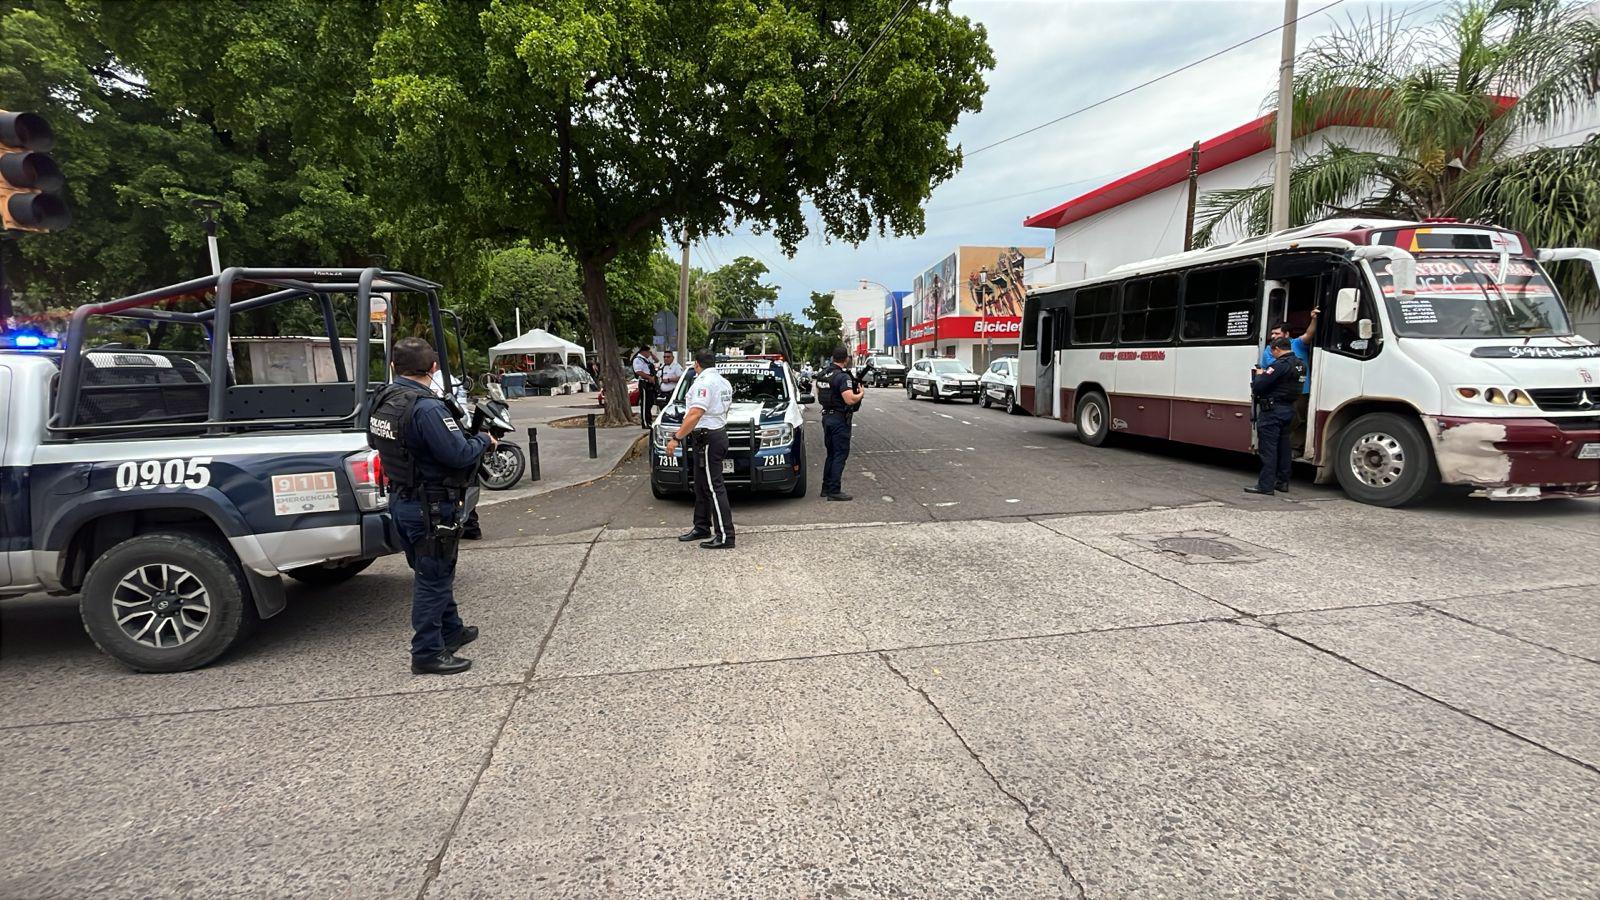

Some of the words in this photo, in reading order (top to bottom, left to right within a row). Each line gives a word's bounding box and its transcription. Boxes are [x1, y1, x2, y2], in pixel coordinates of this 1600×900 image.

[658, 455, 679, 467] 731A
[763, 454, 786, 467] 731A
[116, 456, 214, 492] 0905
